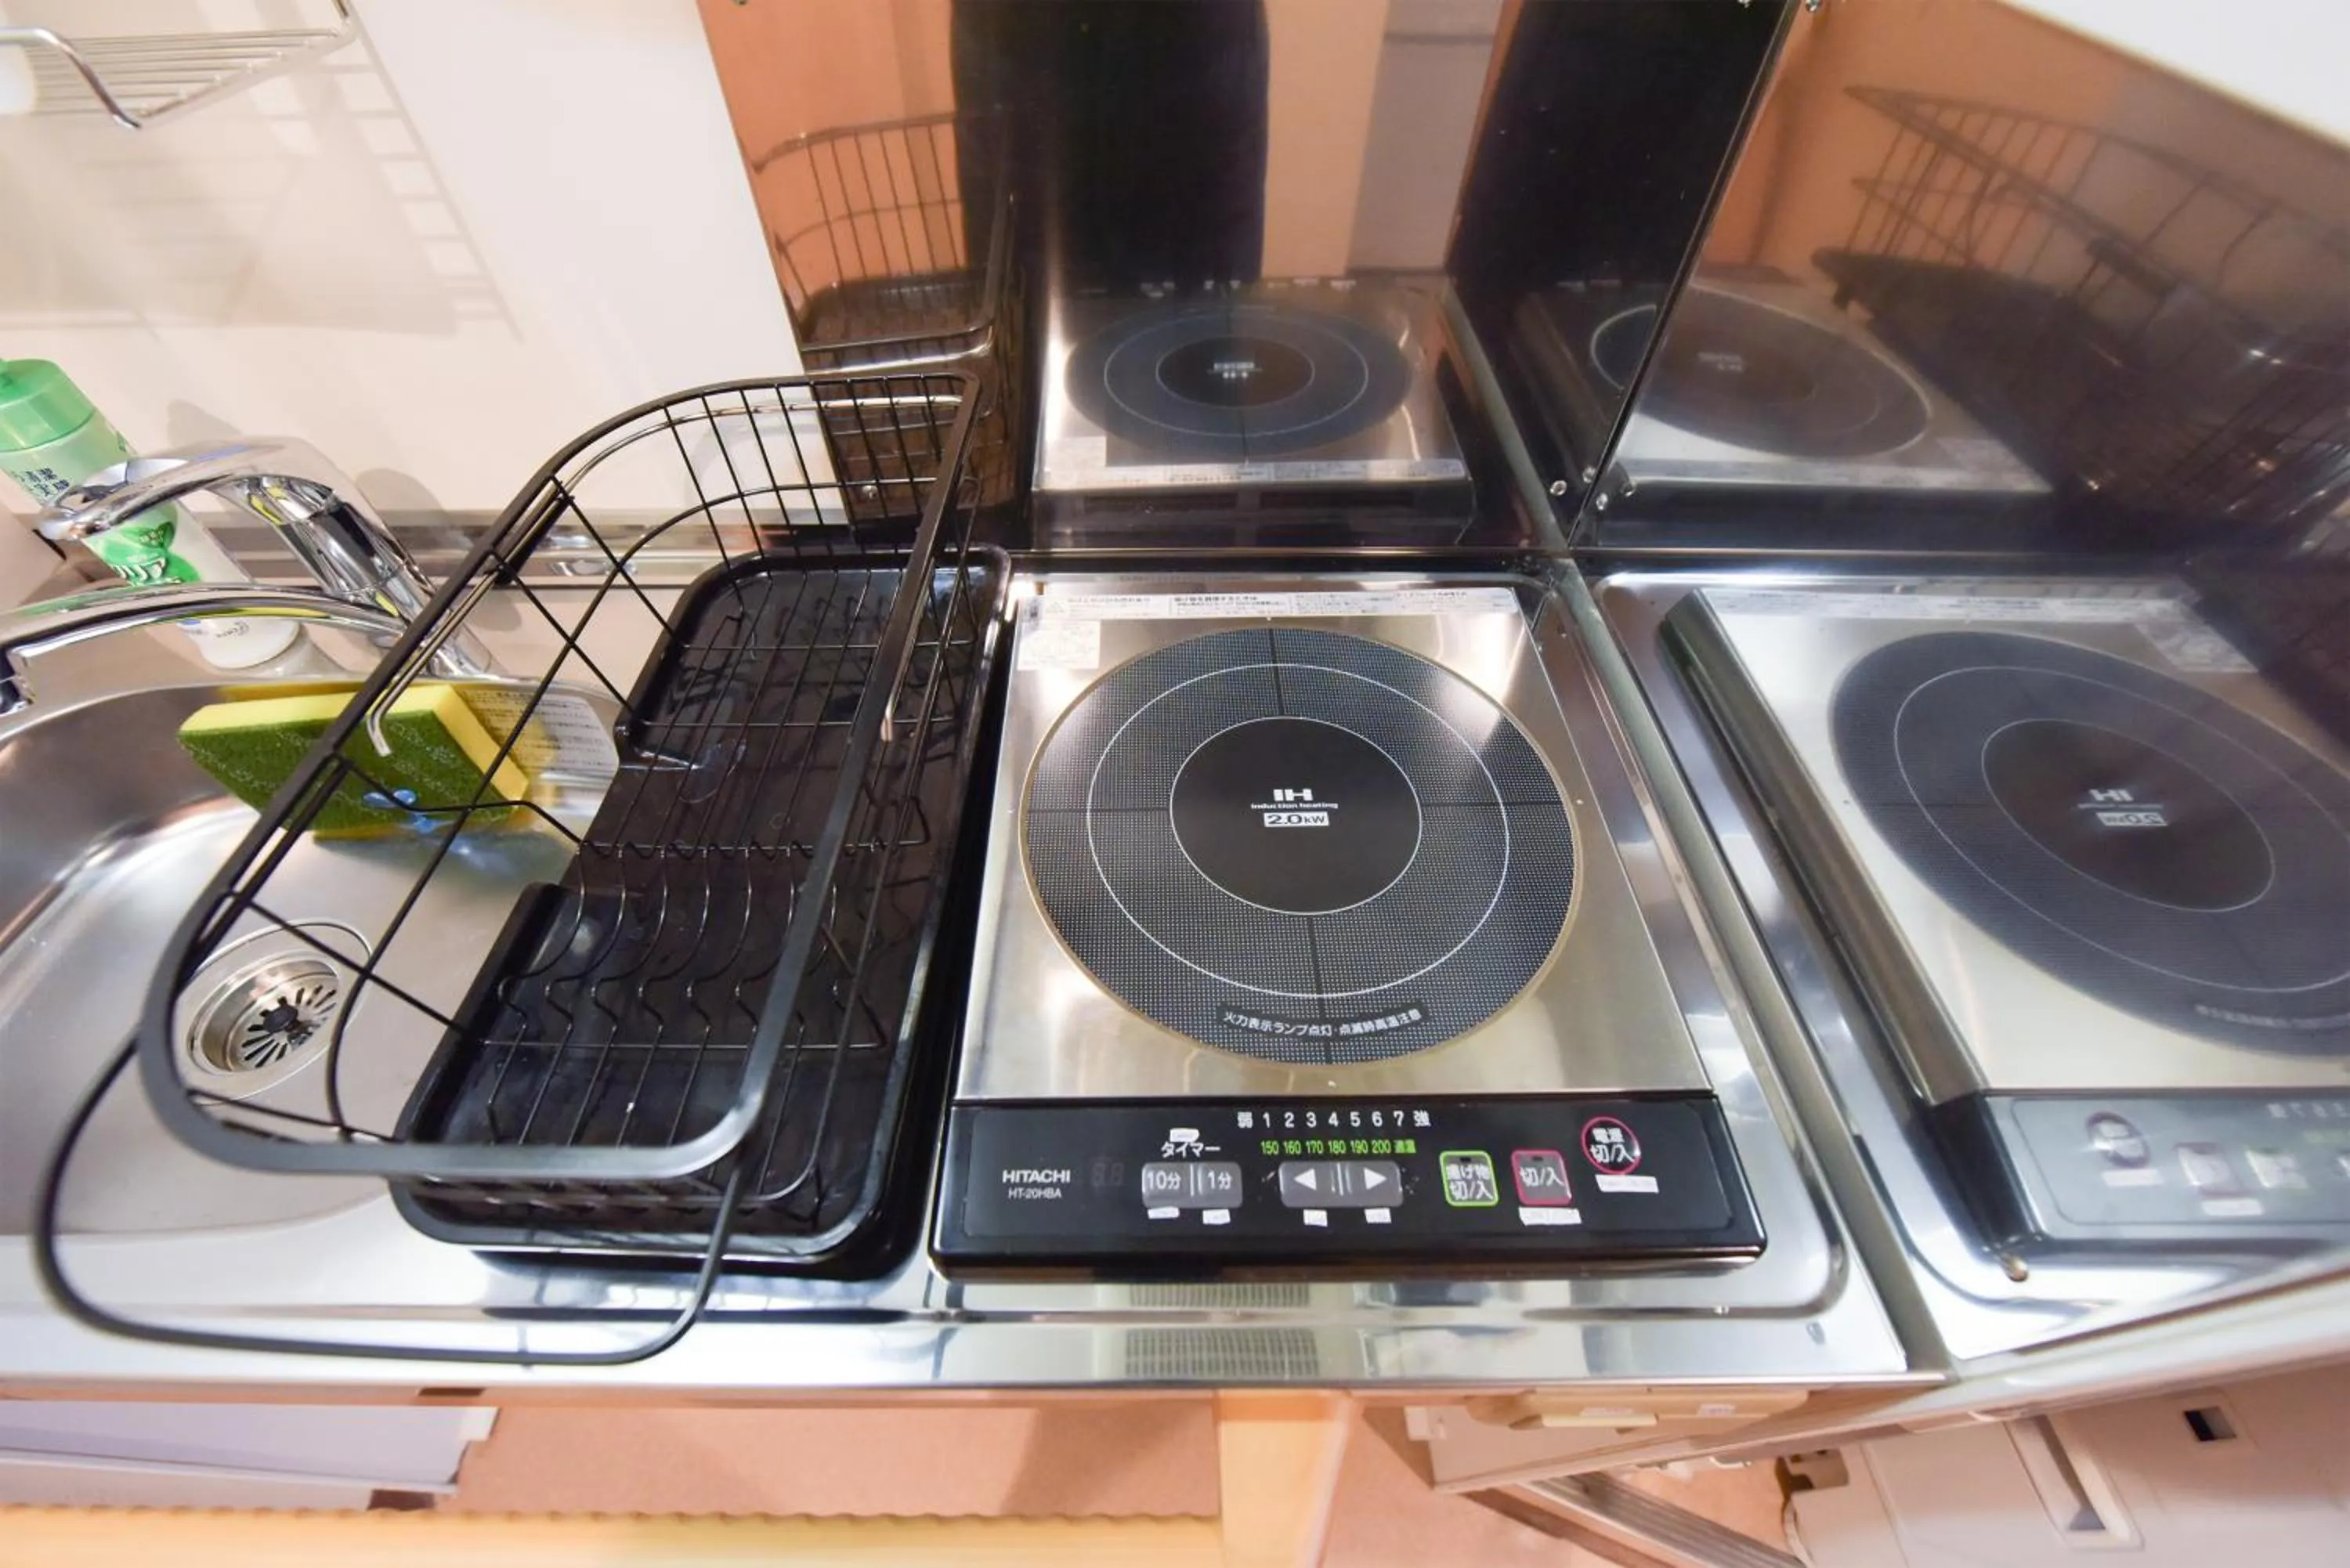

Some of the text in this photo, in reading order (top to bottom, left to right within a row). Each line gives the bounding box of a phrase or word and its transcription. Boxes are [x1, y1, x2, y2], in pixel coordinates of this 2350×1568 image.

[1273, 788, 1314, 802] IH
[1262, 1112, 1271, 1128] 1
[1284, 1111, 1295, 1129] 2
[1306, 1111, 1317, 1129] 3
[1328, 1111, 1339, 1128] 4
[1350, 1111, 1361, 1127] 5
[1372, 1111, 1383, 1127] 6
[1393, 1110, 1405, 1127] 7
[1161, 1141, 1221, 1158] タイマー
[1261, 1140, 1280, 1155] 150
[1283, 1140, 1302, 1155] 160
[1306, 1140, 1324, 1154] 170
[1328, 1140, 1347, 1155] 180
[1350, 1139, 1368, 1154] 190
[1371, 1139, 1392, 1154] 200
[1590, 1143, 1636, 1164] 切/入
[1002, 1169, 1072, 1183] HITACHI
[1147, 1170, 1181, 1190] 10分
[1207, 1170, 1232, 1190] 1分
[1519, 1166, 1564, 1187] 切/入
[1449, 1180, 1494, 1200] 切/入
